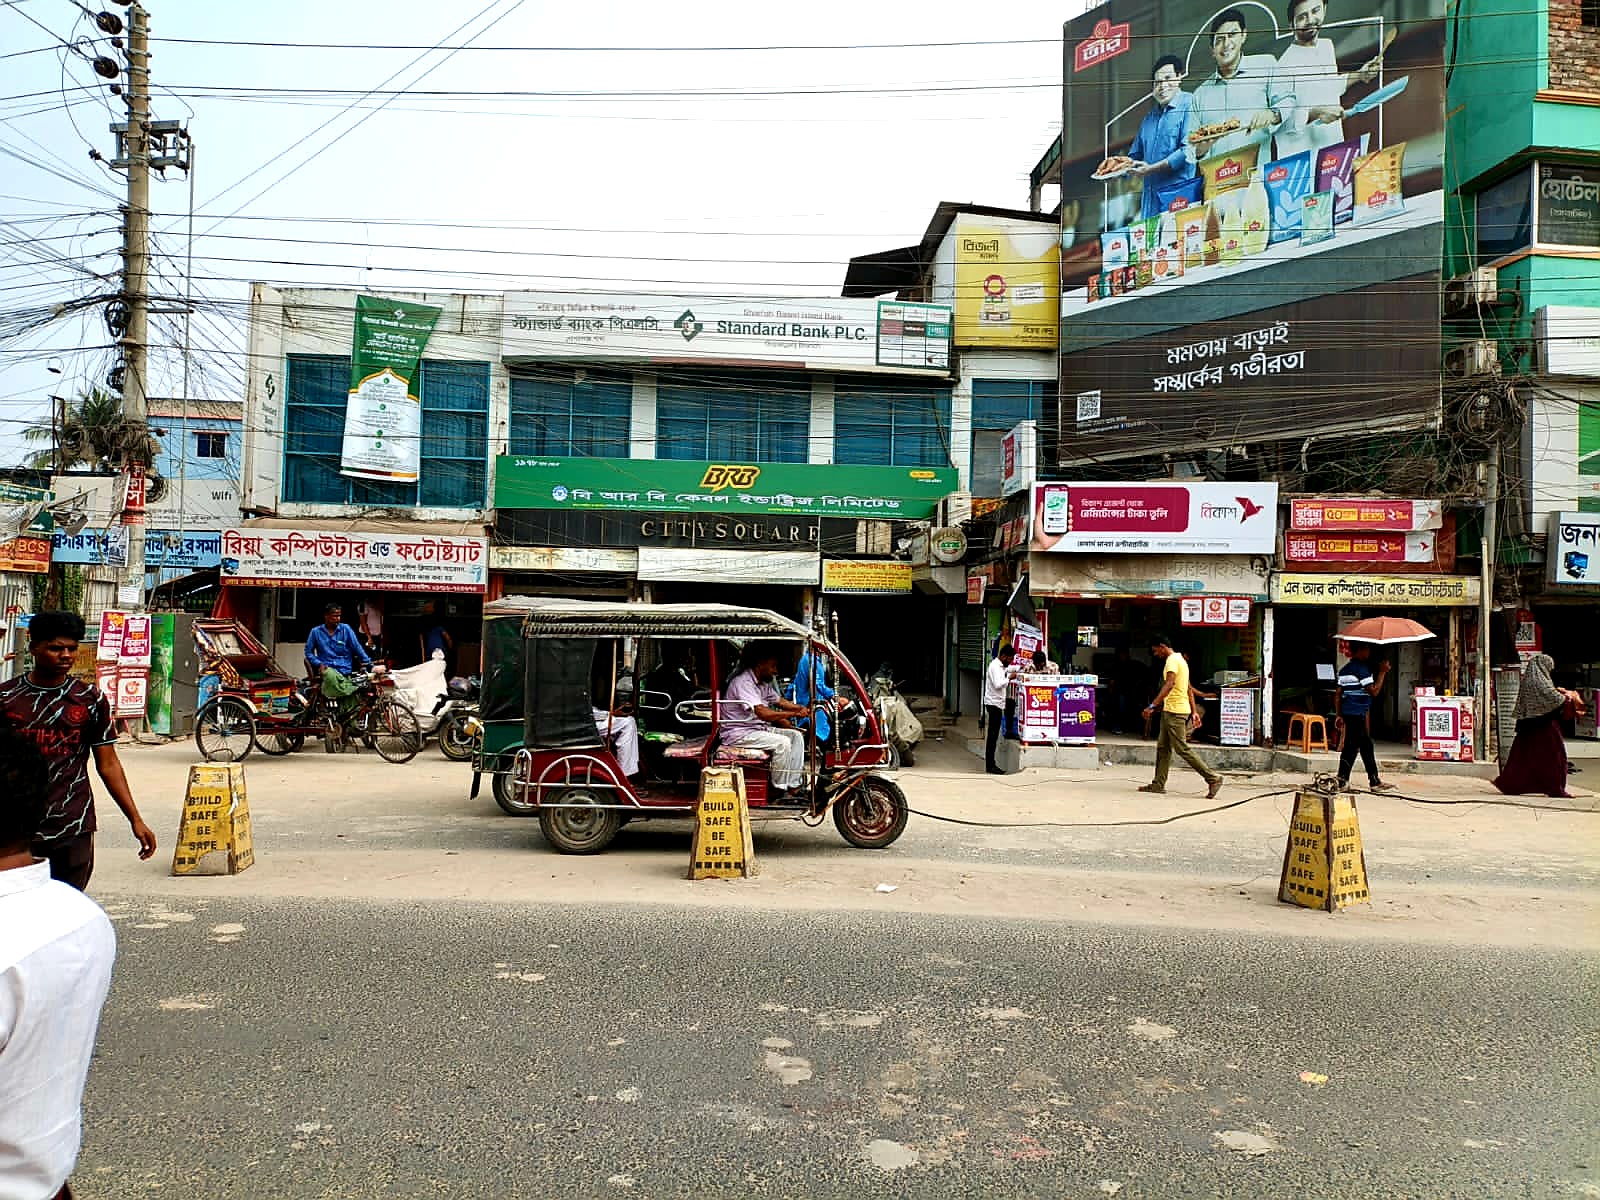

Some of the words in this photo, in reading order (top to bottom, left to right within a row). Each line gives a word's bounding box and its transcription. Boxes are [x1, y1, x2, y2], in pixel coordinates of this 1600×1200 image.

[1082, 34, 1121, 61] তীর
[1541, 175, 1600, 203] হোটেল
[963, 239, 998, 252] বিজলী
[567, 318, 603, 332] ব্যাংক
[717, 320, 786, 336] Standard
[792, 324, 829, 339] Bank
[835, 326, 868, 340] PLC.
[1167, 338, 1227, 364] মমতায়
[1233, 321, 1289, 352] বাড়াই
[1153, 364, 1224, 392] সম্পর্কের
[1230, 350, 1305, 379] গভীরতা
[701, 465, 760, 488] BRB
[571, 488, 593, 500] বি
[600, 491, 640, 503] আর
[647, 490, 667, 503] বি
[675, 492, 729, 505] কেবল
[821, 495, 902, 509] লিমিটেড
[1127, 508, 1148, 518] টাকা
[1149, 508, 1169, 520] তুলি
[1201, 503, 1237, 520] বিকাশ
[1296, 508, 1322, 519] সুবিধা
[19, 539, 46, 553] BCS
[223, 530, 264, 558] রিয়া
[270, 533, 368, 560] কম্পিউটার
[369, 541, 391, 557] এন্ড
[1290, 540, 1316, 550] সুবিধা
[1284, 581, 1299, 593] এন
[1328, 579, 1385, 595] কম্পিউটার
[16, 729, 81, 743] TIHAD
[188, 795, 222, 806] BUILD
[703, 802, 734, 811] BUILD
[191, 810, 218, 821] SAFE
[705, 817, 732, 826] SAFE
[196, 826, 211, 835] BE
[1293, 821, 1322, 834] BUILD
[1333, 827, 1356, 840] BUILD
[711, 831, 725, 840] BE
[189, 841, 217, 850] SAFE
[1294, 837, 1319, 850] SAFE
[1336, 843, 1355, 855] SAFE
[705, 846, 732, 856] SAFE
[1298, 853, 1311, 863] BE
[1342, 860, 1353, 869] BE
[1290, 867, 1315, 881] SAFE
[1339, 874, 1359, 887] SAFE
